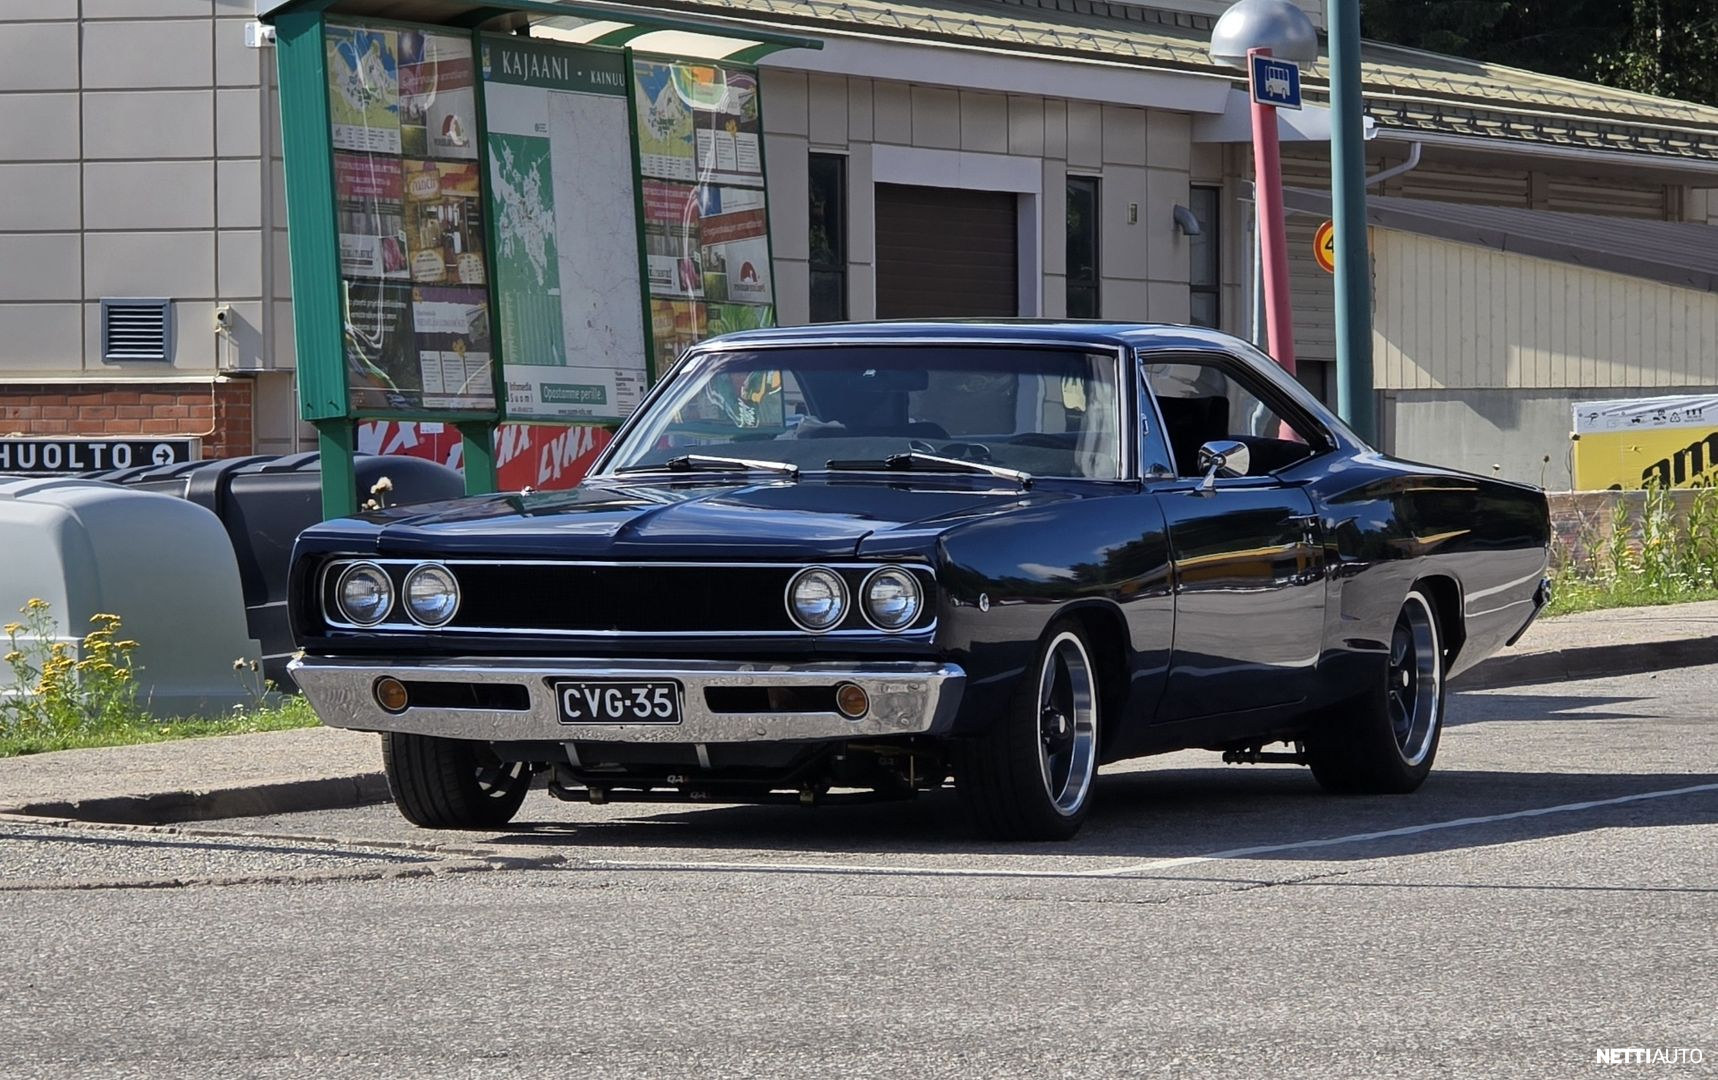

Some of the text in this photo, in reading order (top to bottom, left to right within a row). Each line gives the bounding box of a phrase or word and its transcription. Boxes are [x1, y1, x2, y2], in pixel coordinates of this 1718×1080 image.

[502, 51, 569, 81] KAJAANI
[1325, 234, 1334, 253] 4
[538, 426, 594, 486] LYNX
[563, 688, 673, 718] CVG-35
